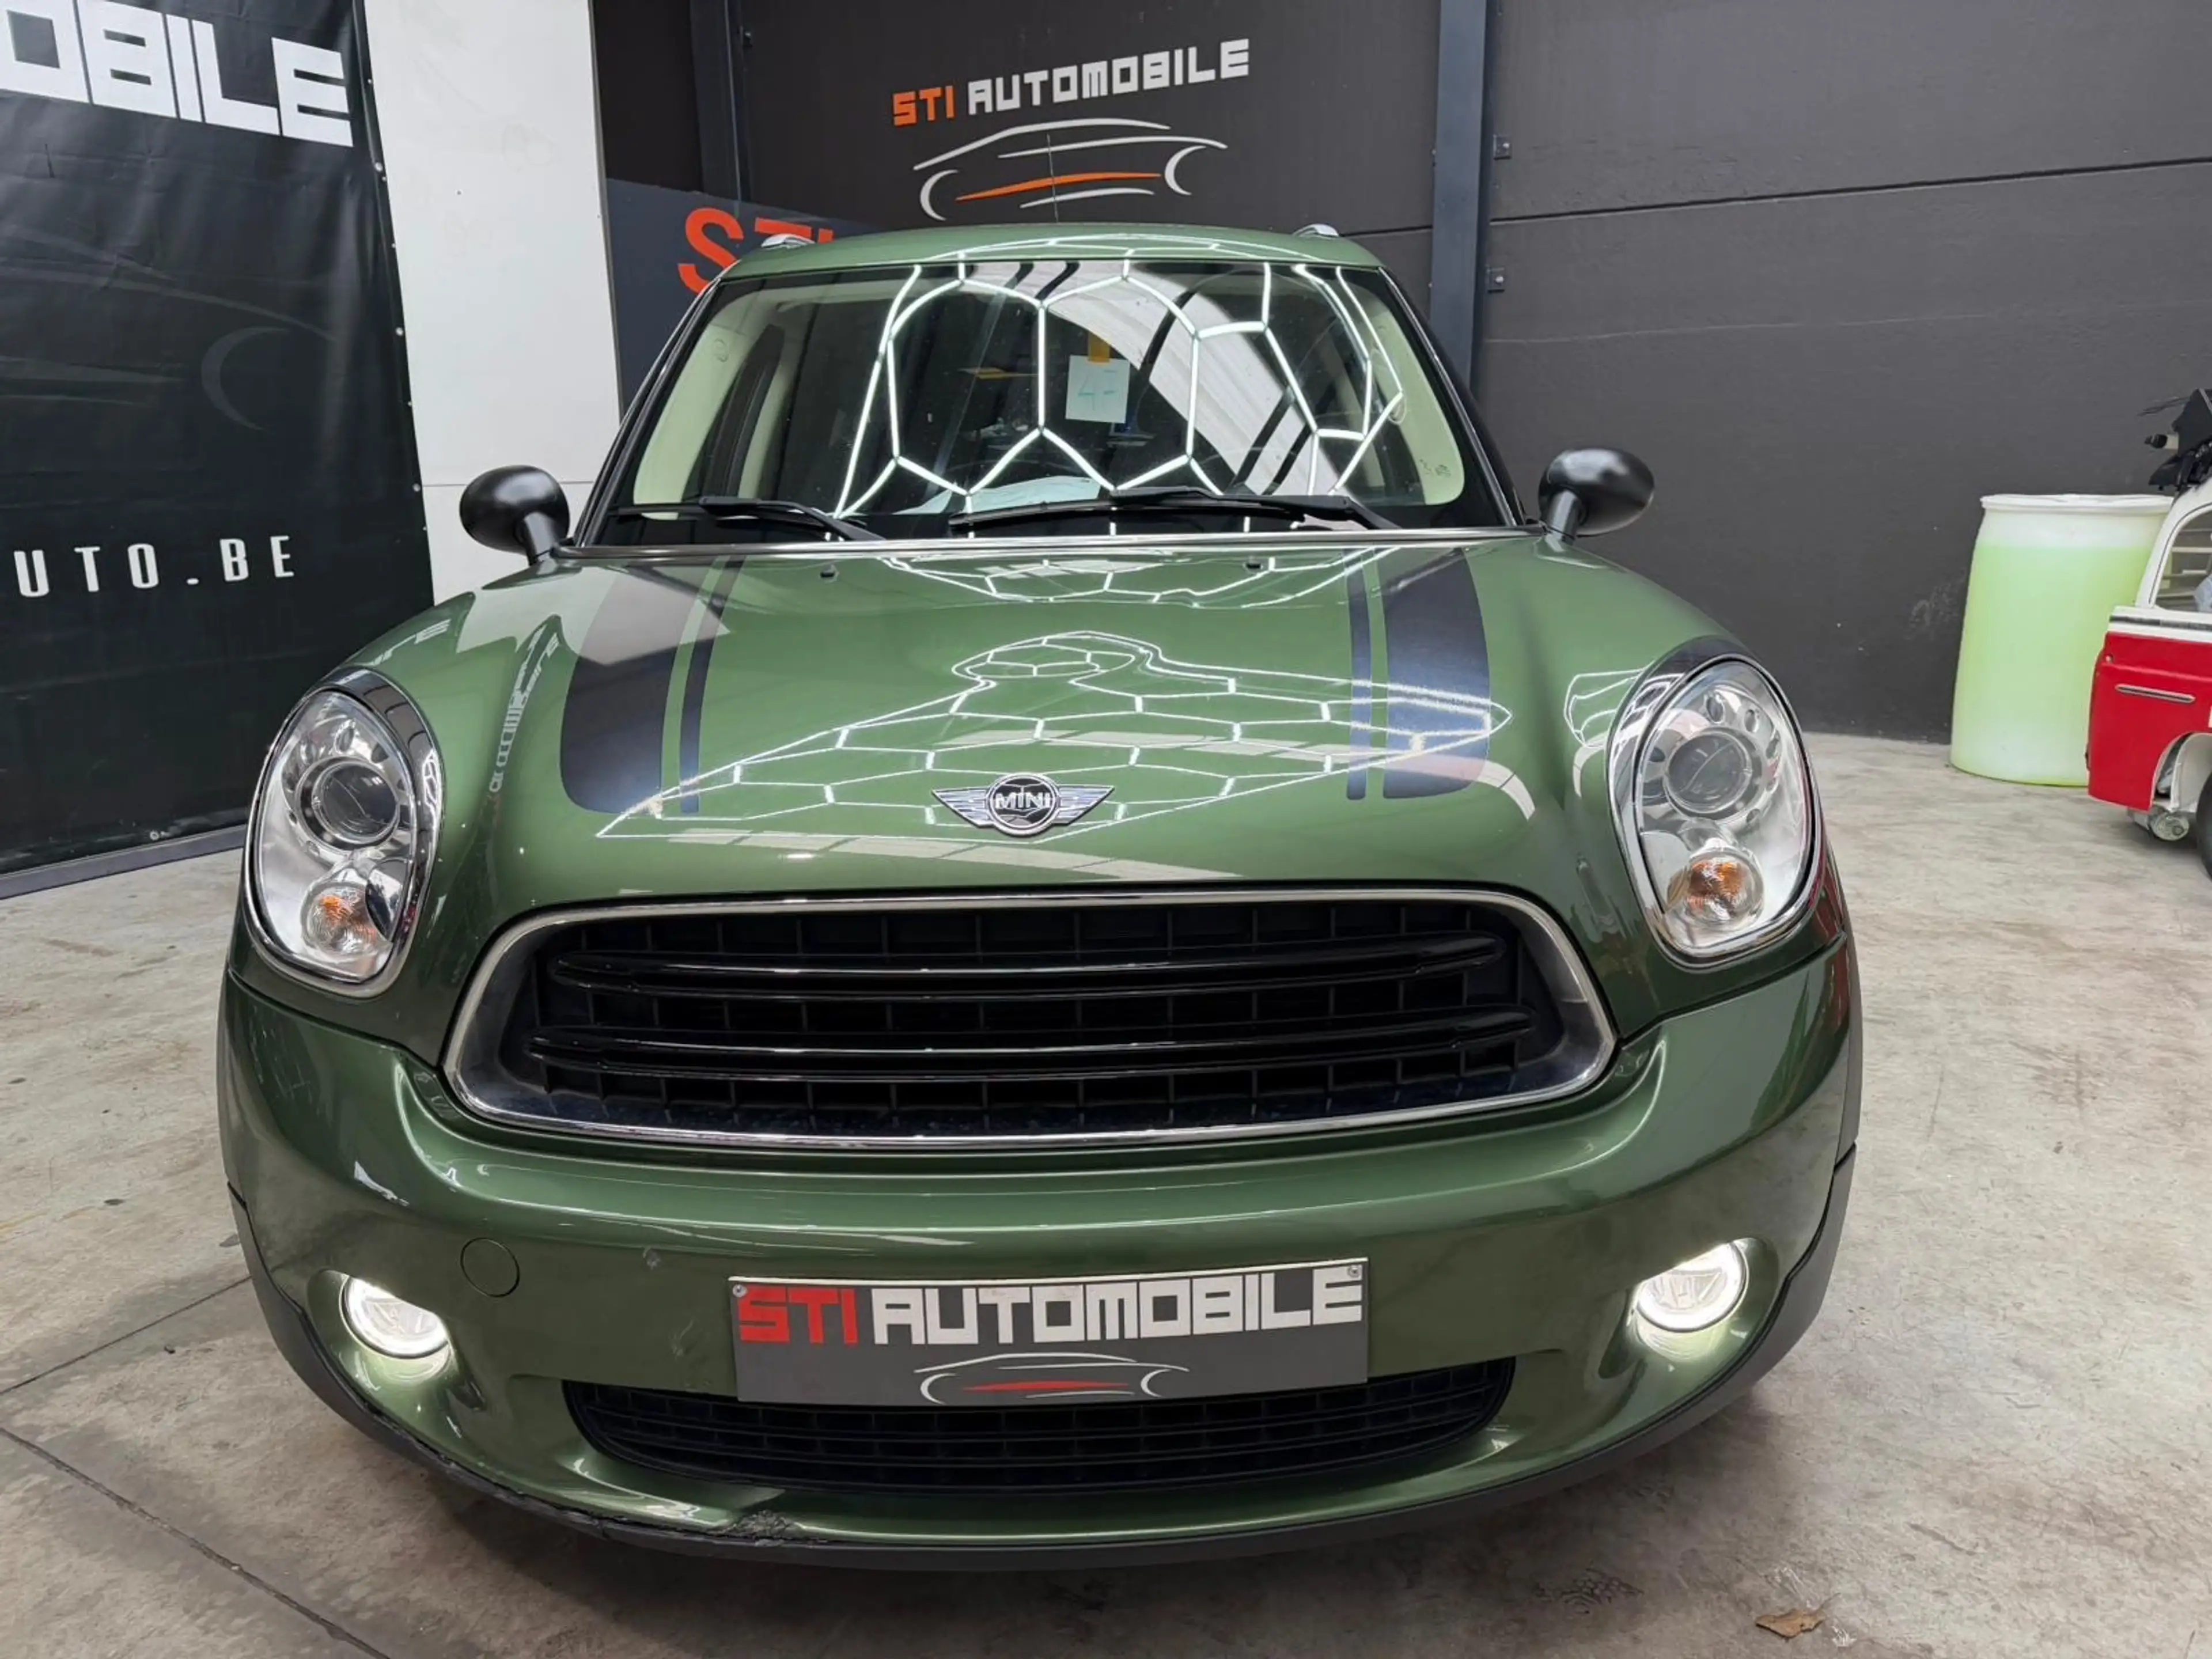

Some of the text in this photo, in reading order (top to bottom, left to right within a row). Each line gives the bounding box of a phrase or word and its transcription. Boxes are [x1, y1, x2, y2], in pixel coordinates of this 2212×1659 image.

[0, 0, 353, 146] OBILE
[892, 38, 1249, 127] STI AUTOMOBILE
[995, 791, 1051, 809] MINI
[737, 1266, 1362, 1345] STI AUTOMOBILE
